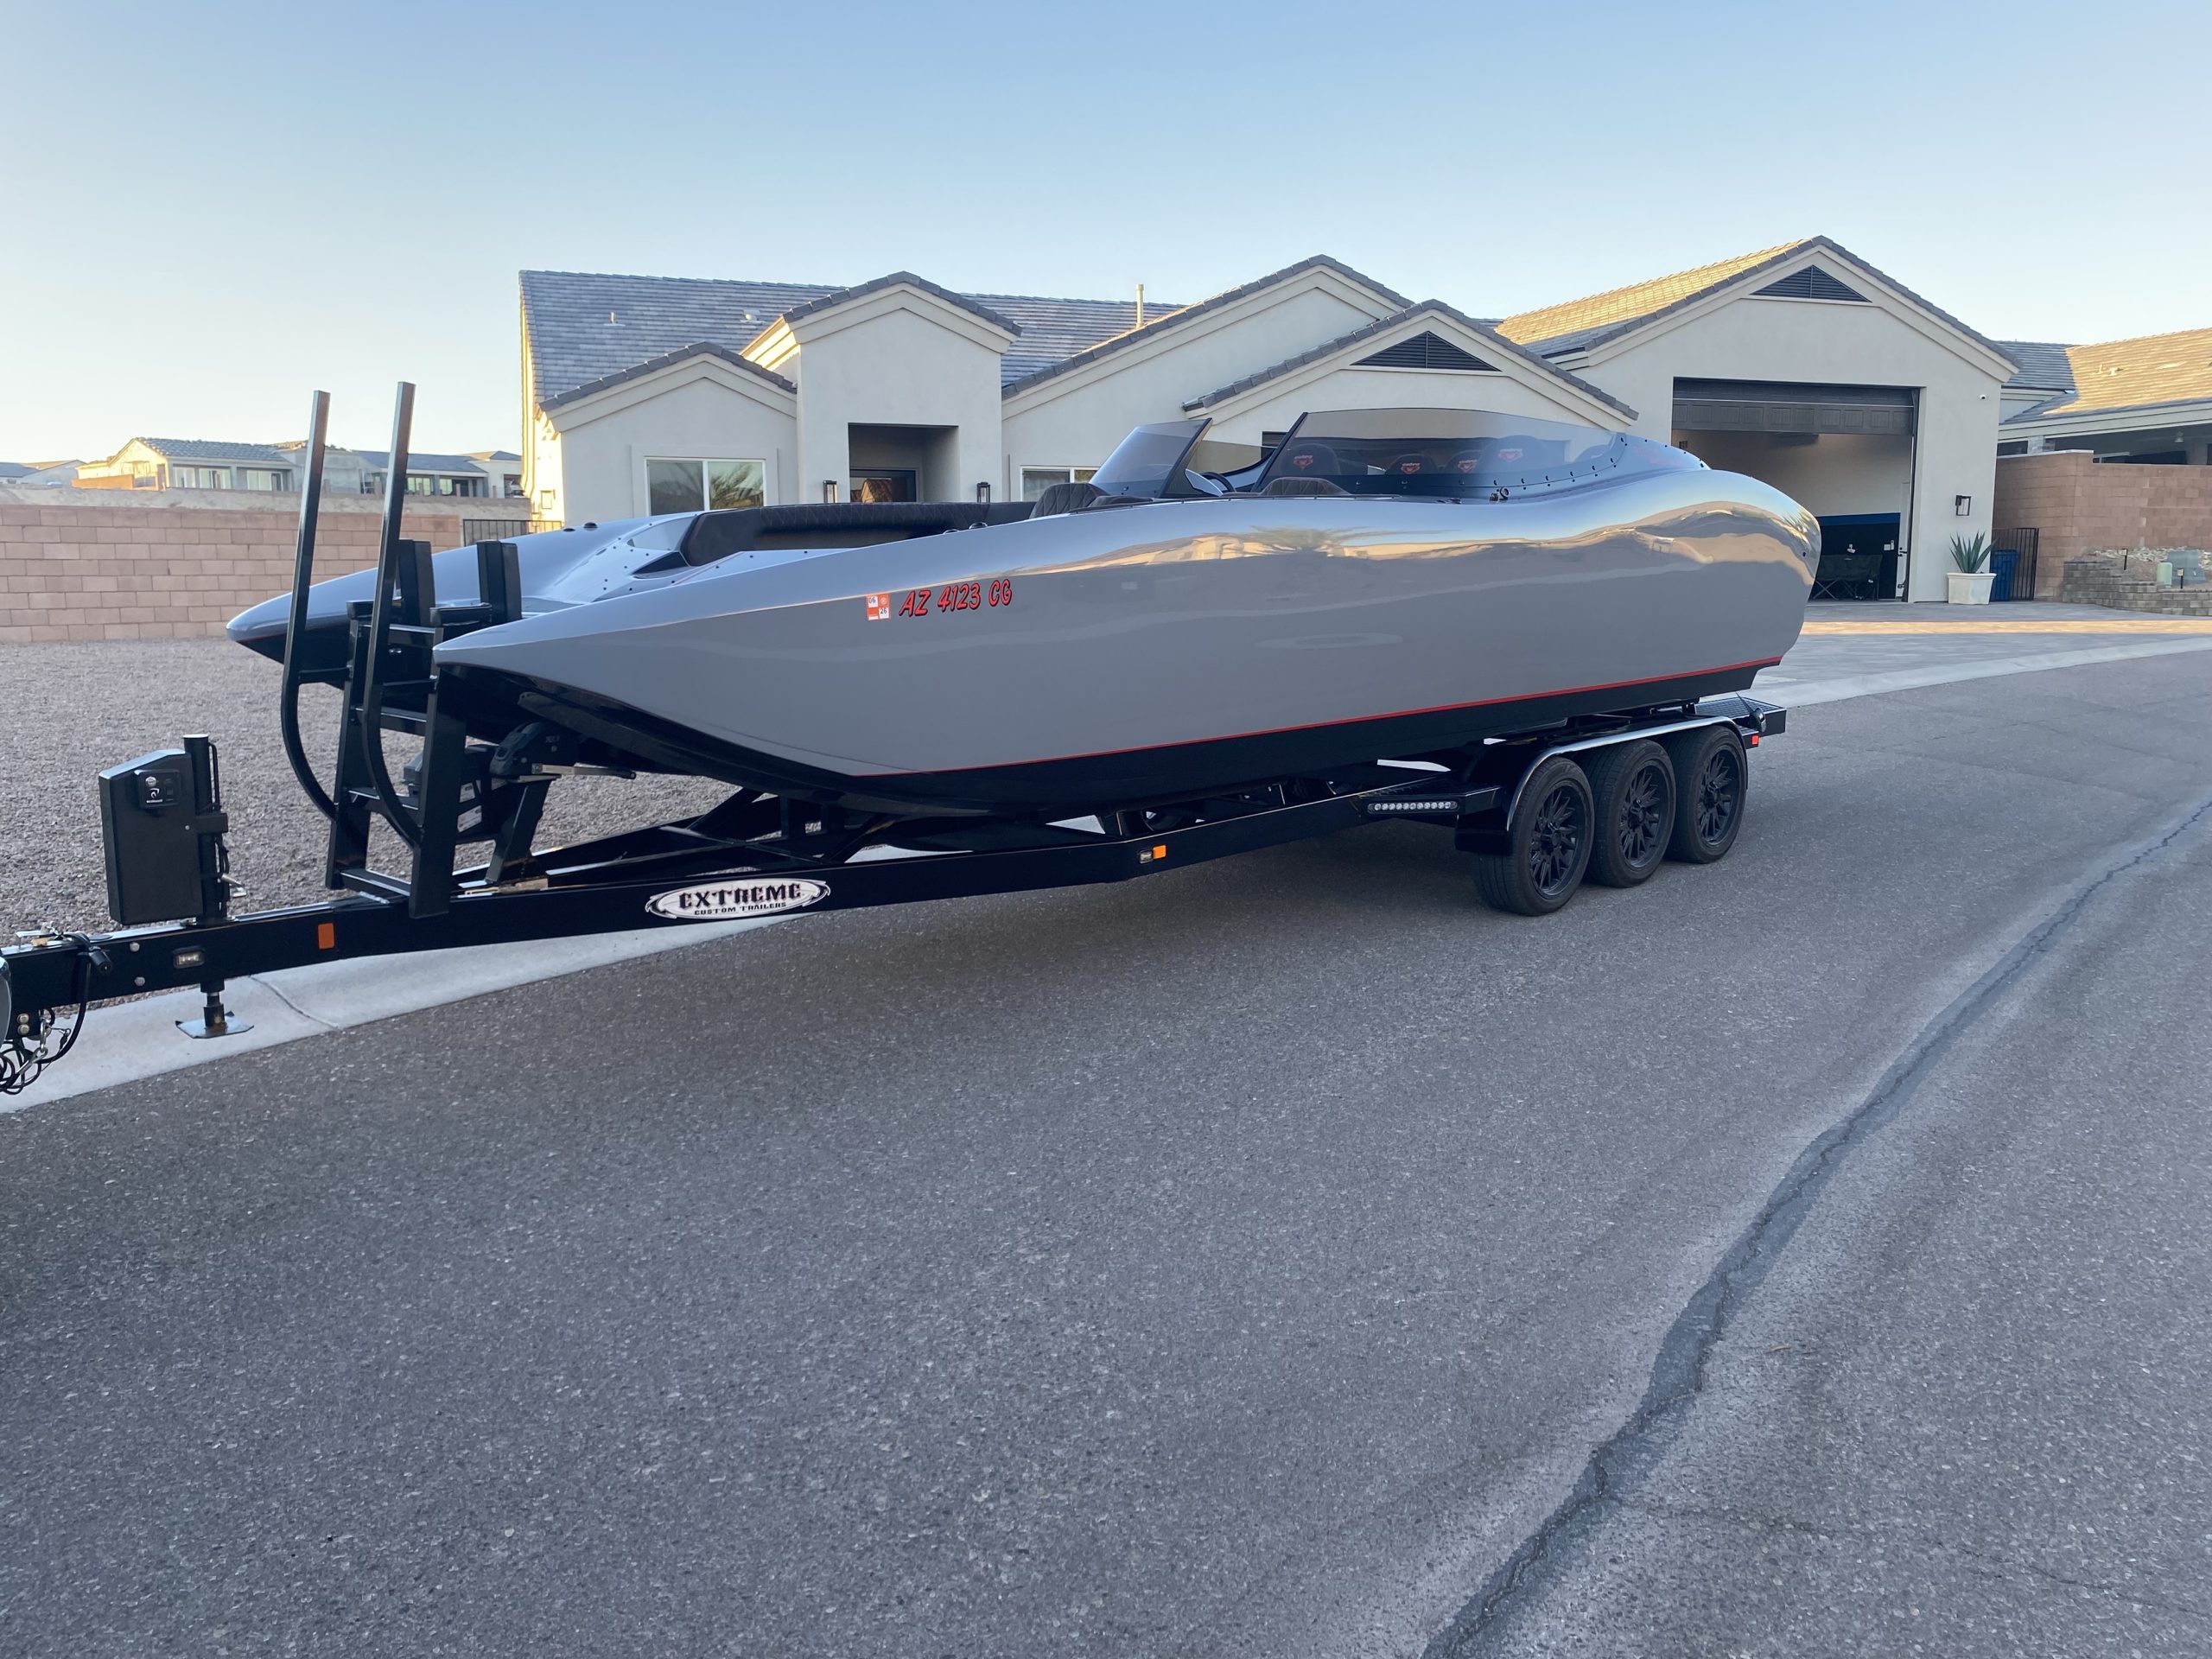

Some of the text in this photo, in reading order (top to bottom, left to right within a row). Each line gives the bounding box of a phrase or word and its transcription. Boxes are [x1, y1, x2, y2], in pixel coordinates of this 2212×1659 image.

[899, 579, 1013, 617] AZ 4123 CG
[678, 882, 802, 910] EXTREME
[694, 901, 787, 916] CUSTOM TRAILERS
